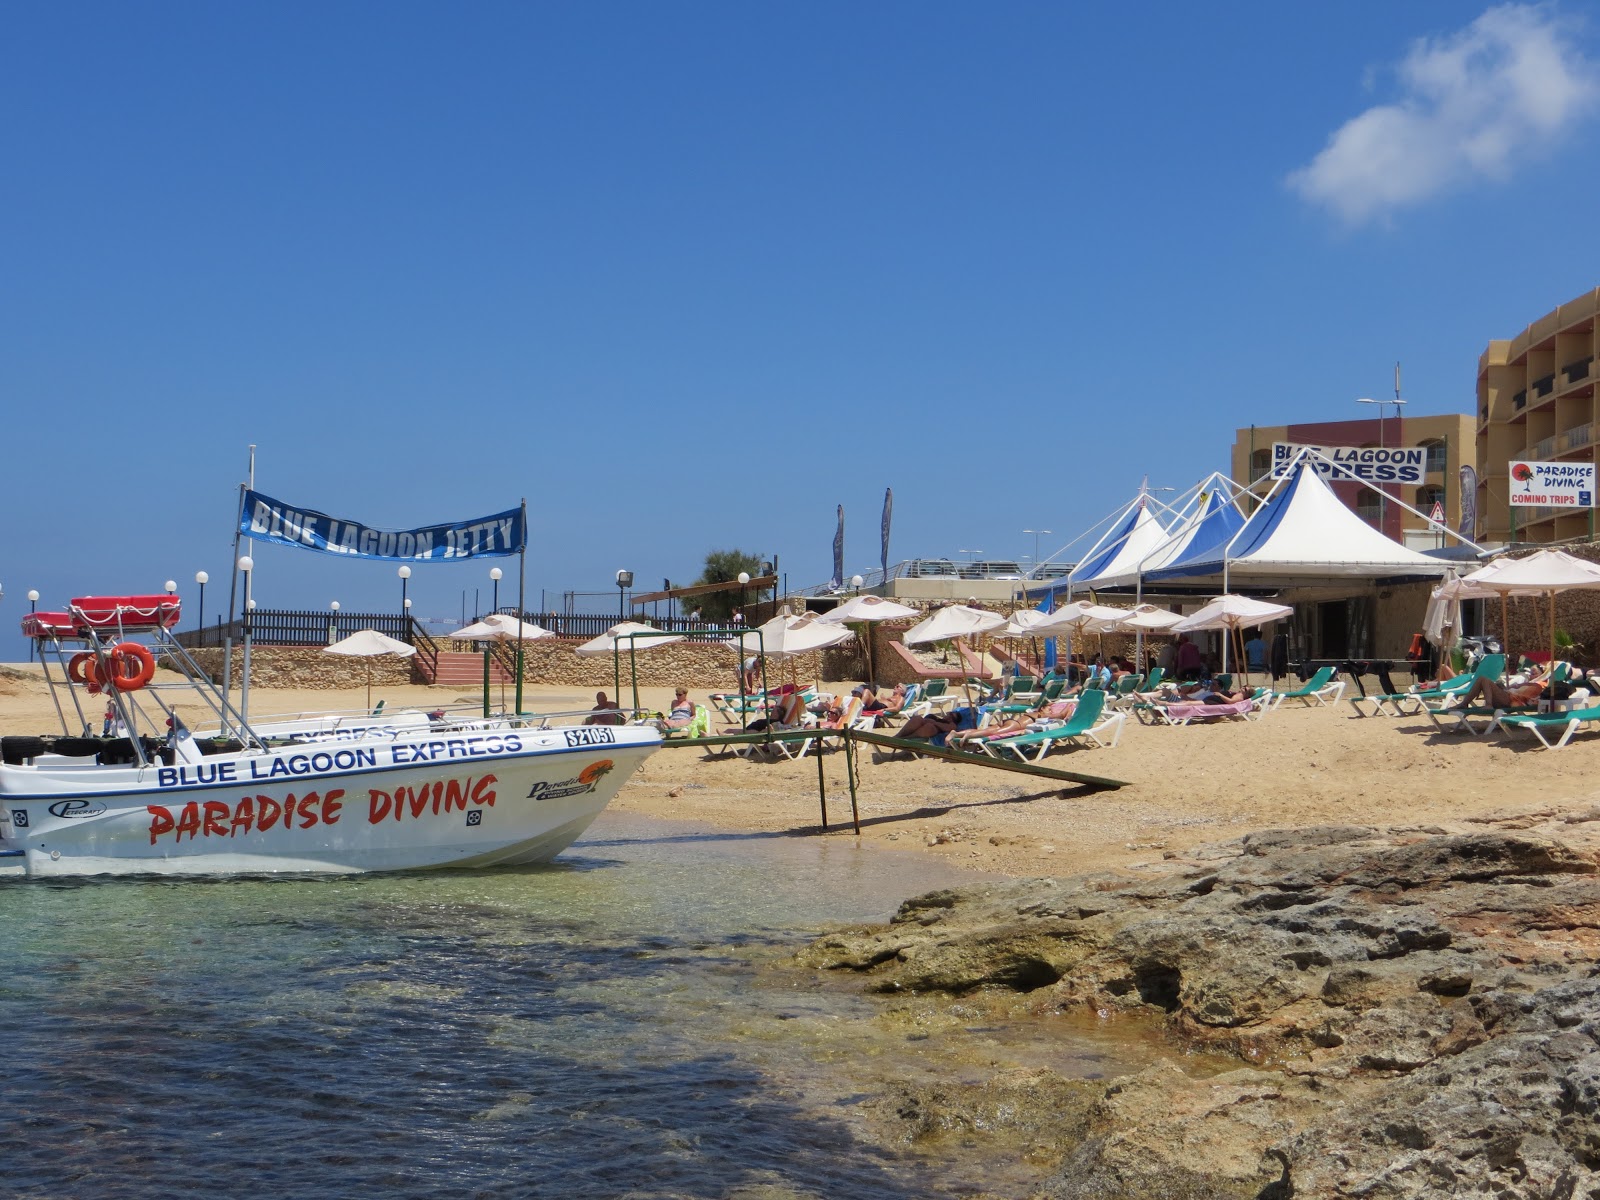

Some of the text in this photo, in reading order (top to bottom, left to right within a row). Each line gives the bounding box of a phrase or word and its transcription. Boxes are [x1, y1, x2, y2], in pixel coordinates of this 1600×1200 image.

[1333, 449, 1421, 464] LAGOON
[1536, 466, 1593, 477] PARADISE
[1544, 477, 1585, 489] DIVING
[1512, 494, 1547, 504] COMINO
[1549, 495, 1575, 504] TRIPS
[251, 499, 514, 559] BLUE LAGOON JETTY
[566, 728, 614, 747] S21051
[158, 734, 523, 787] BLUE LAGOON EXPRESS
[147, 774, 498, 846] PARADISE DIVING
